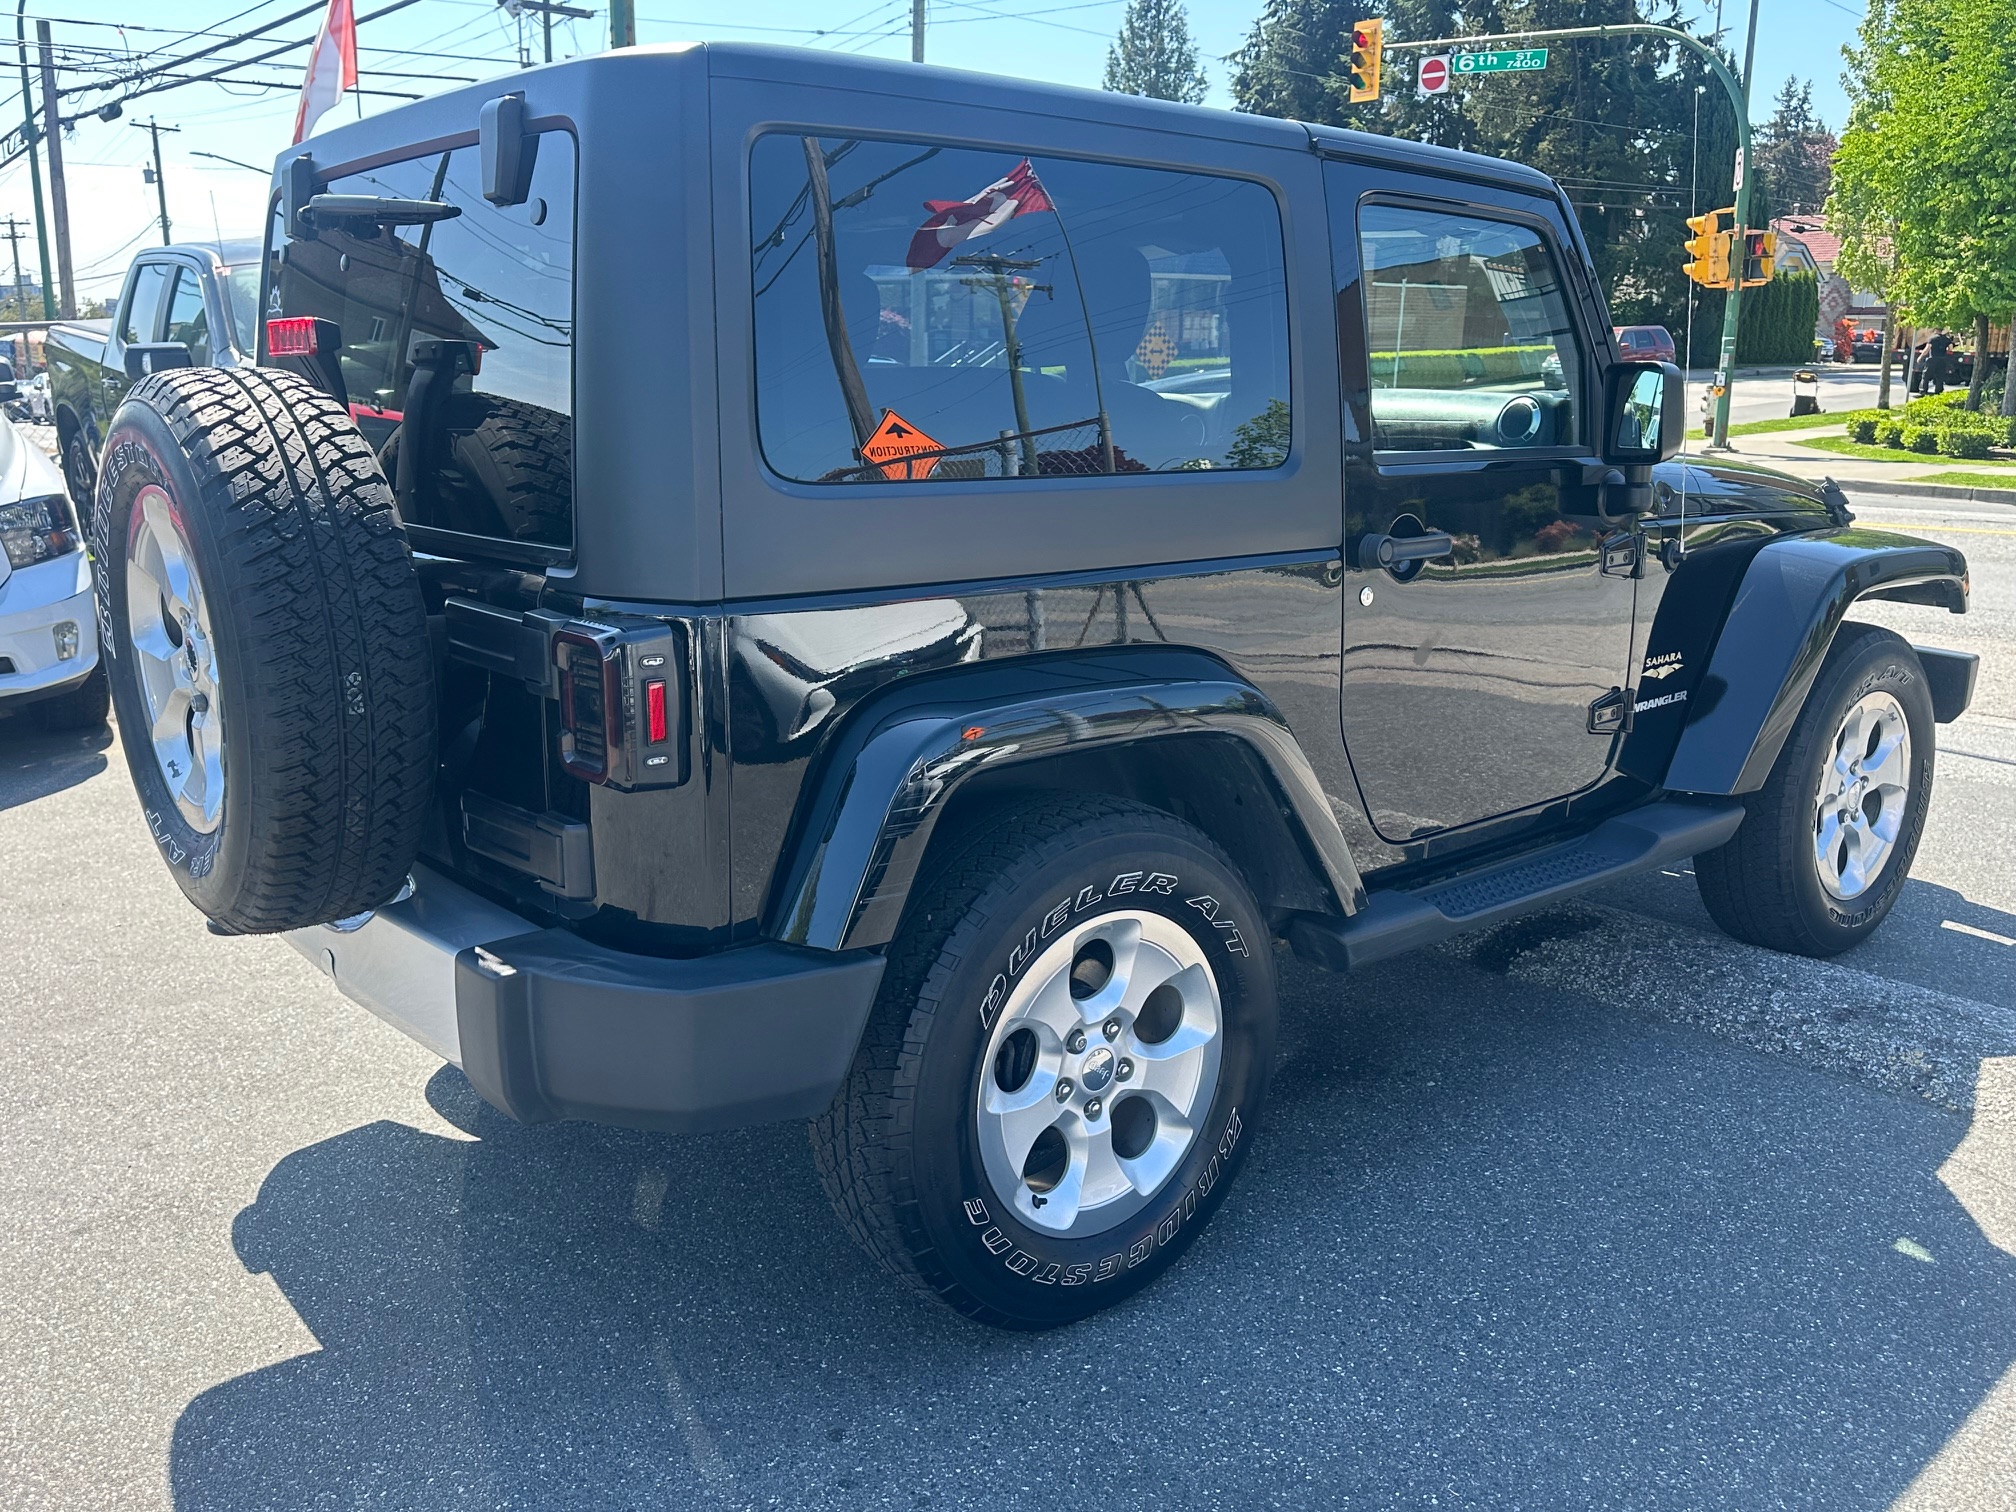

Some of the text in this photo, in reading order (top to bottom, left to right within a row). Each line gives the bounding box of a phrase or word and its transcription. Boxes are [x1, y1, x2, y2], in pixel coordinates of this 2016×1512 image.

[1459, 52, 1533, 71] 6th ST
[1506, 59, 1541, 69] 7400
[1645, 651, 1682, 667] SAHARA
[1634, 690, 1688, 712] WRANGLER
[979, 870, 1249, 1031] DUELER A/T
[963, 1106, 1243, 1286] BRIDGESTONE
